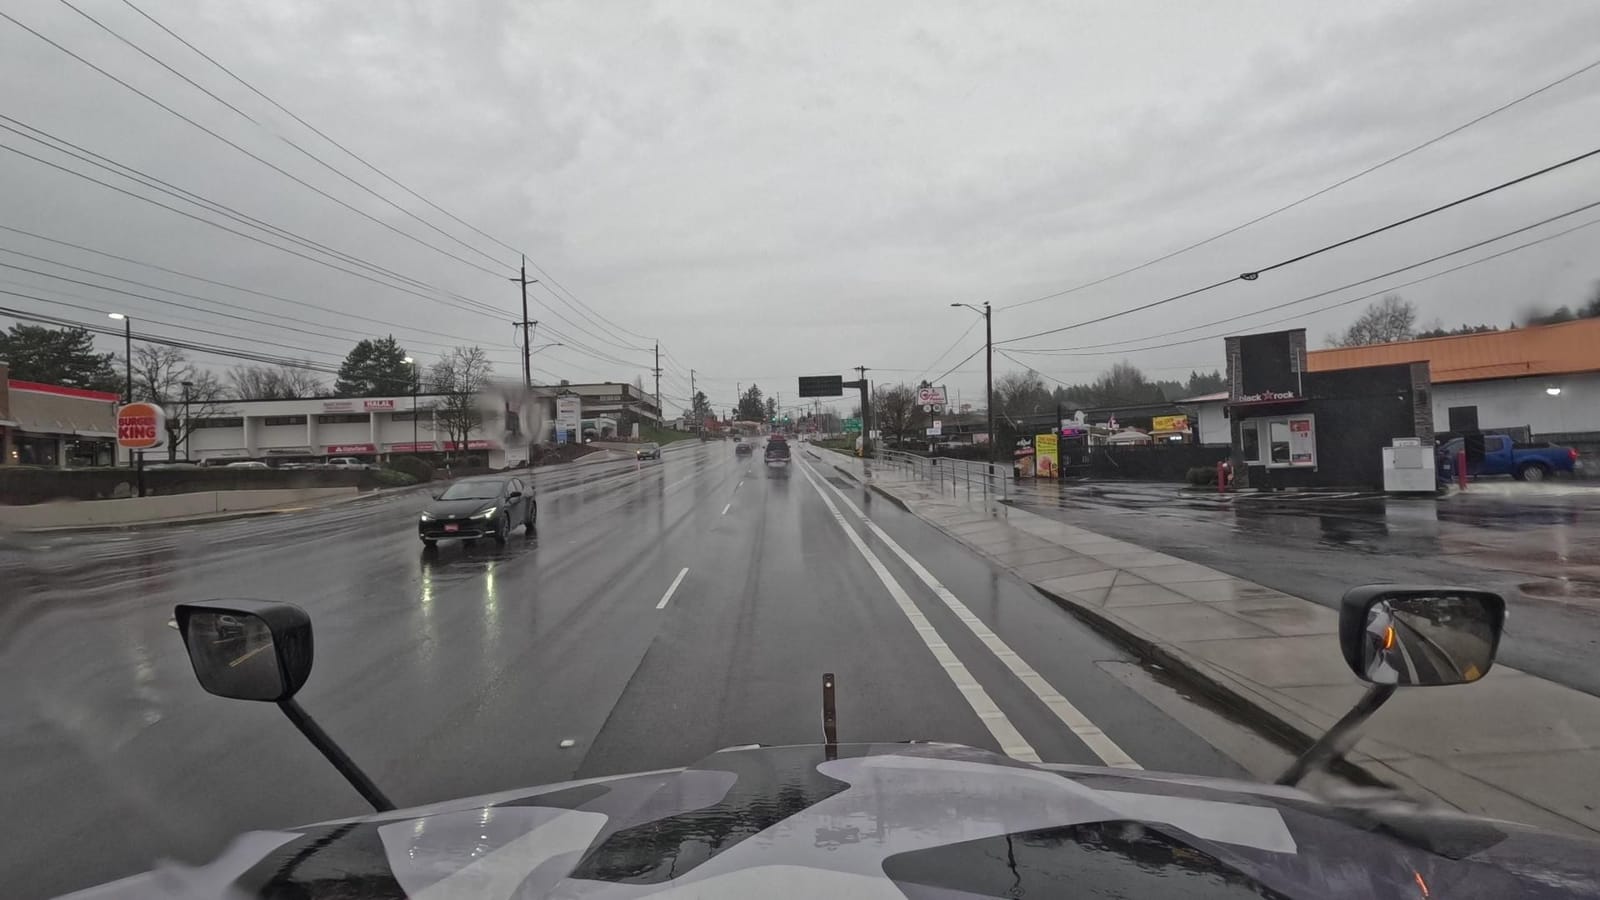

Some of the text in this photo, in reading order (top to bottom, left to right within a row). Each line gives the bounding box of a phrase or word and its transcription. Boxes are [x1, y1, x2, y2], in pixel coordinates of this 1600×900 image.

[1239, 391, 1294, 402] black rock
[118, 417, 156, 426] BURGER
[118, 426, 156, 439] KING
